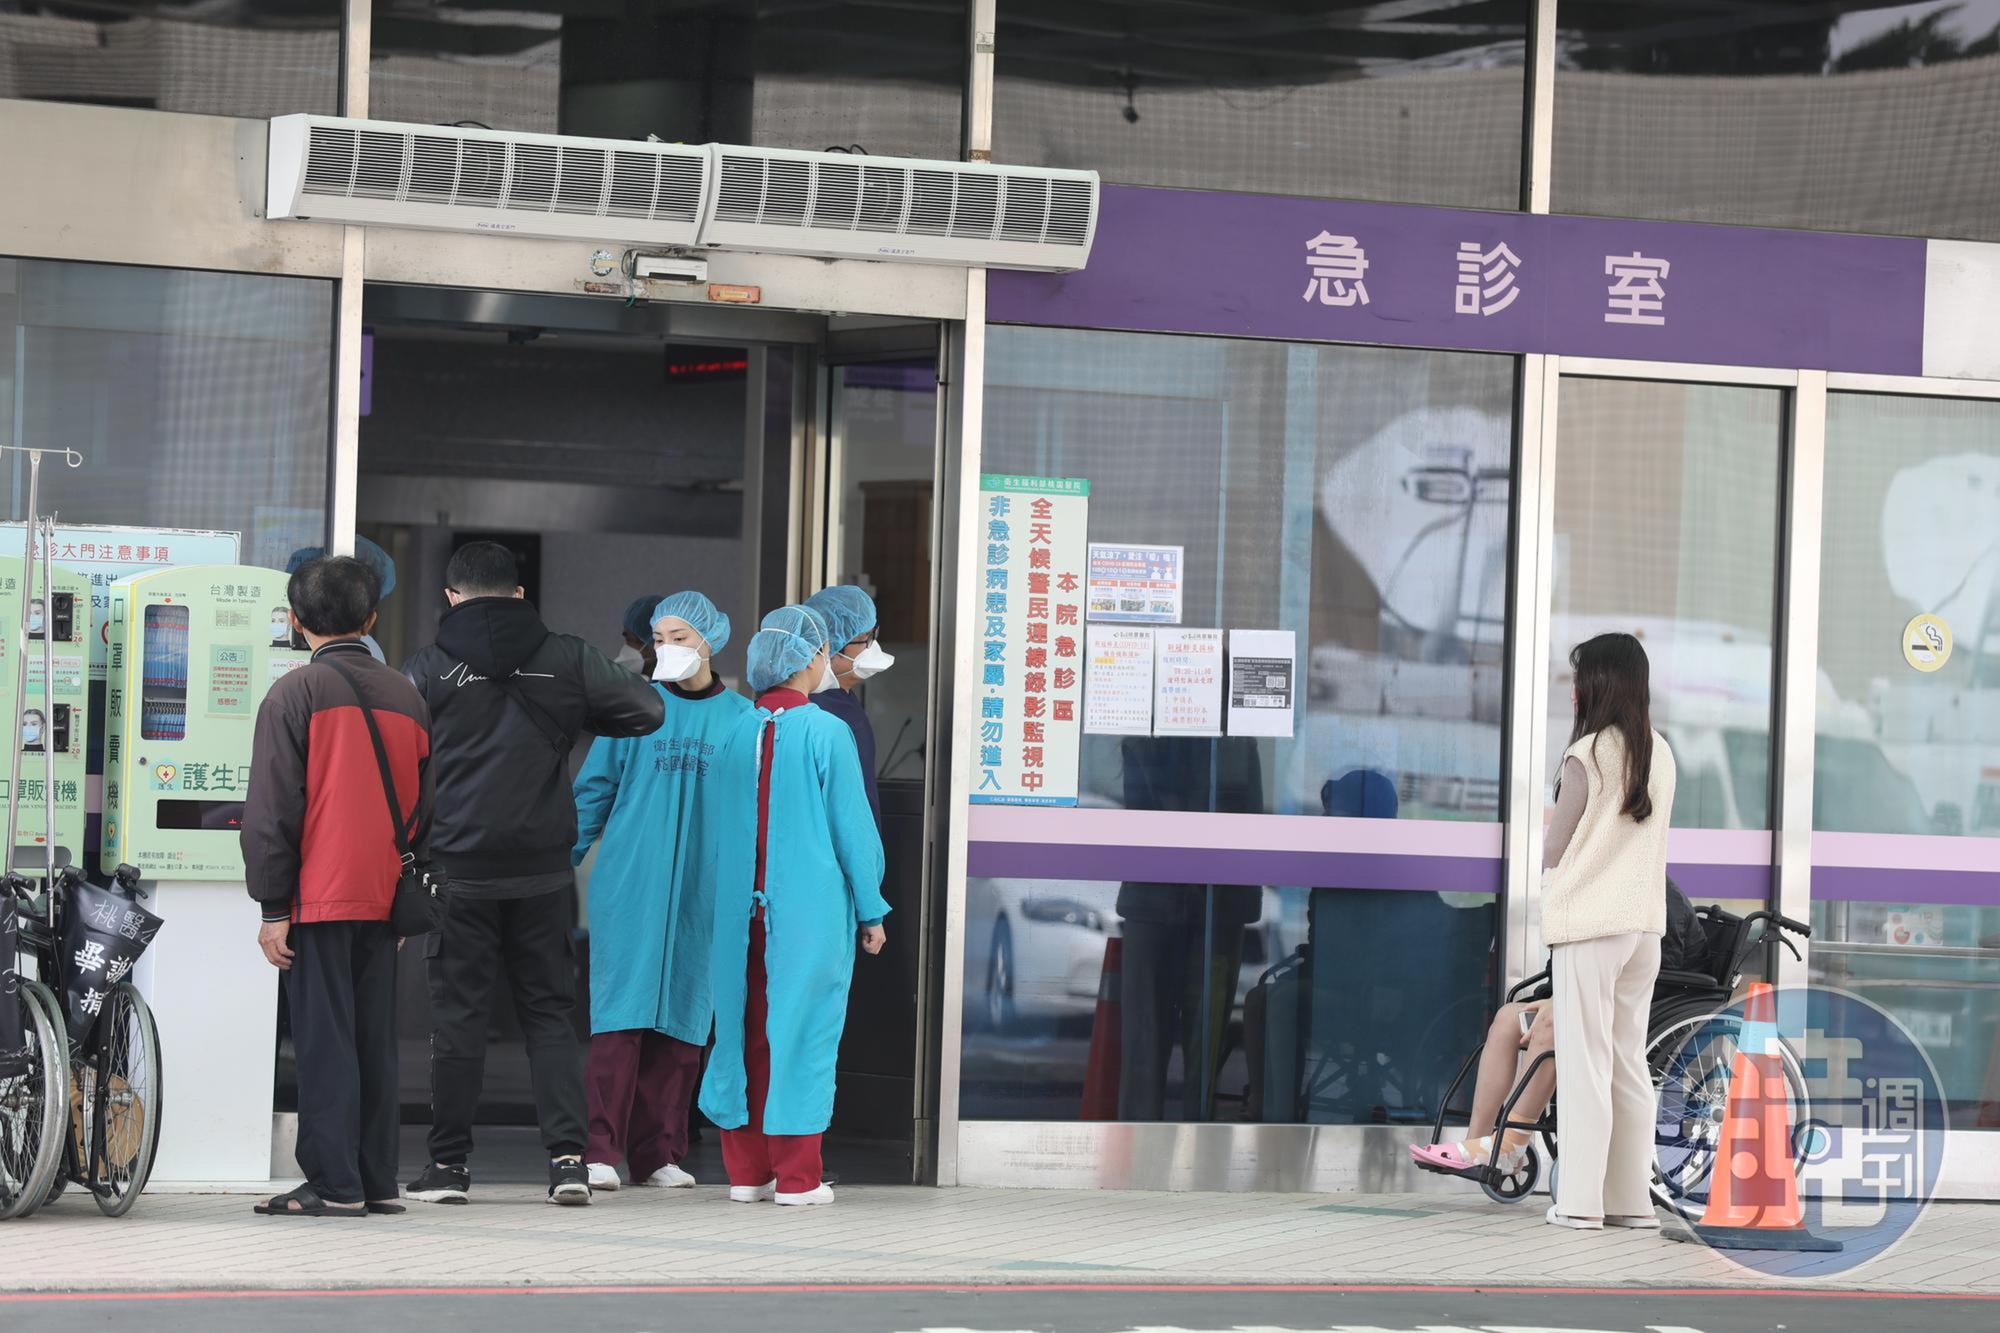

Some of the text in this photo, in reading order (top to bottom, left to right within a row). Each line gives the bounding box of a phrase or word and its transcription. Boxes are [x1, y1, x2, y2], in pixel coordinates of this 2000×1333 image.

[1303, 231, 1671, 326] 急診室
[210, 583, 262, 598] 台灣製造
[1021, 497, 1053, 792] 全天候警民連線錄影監視中
[1052, 572, 1079, 721] 本院急診區
[107, 598, 124, 810] 口罩販賣機
[219, 652, 239, 662] 公告
